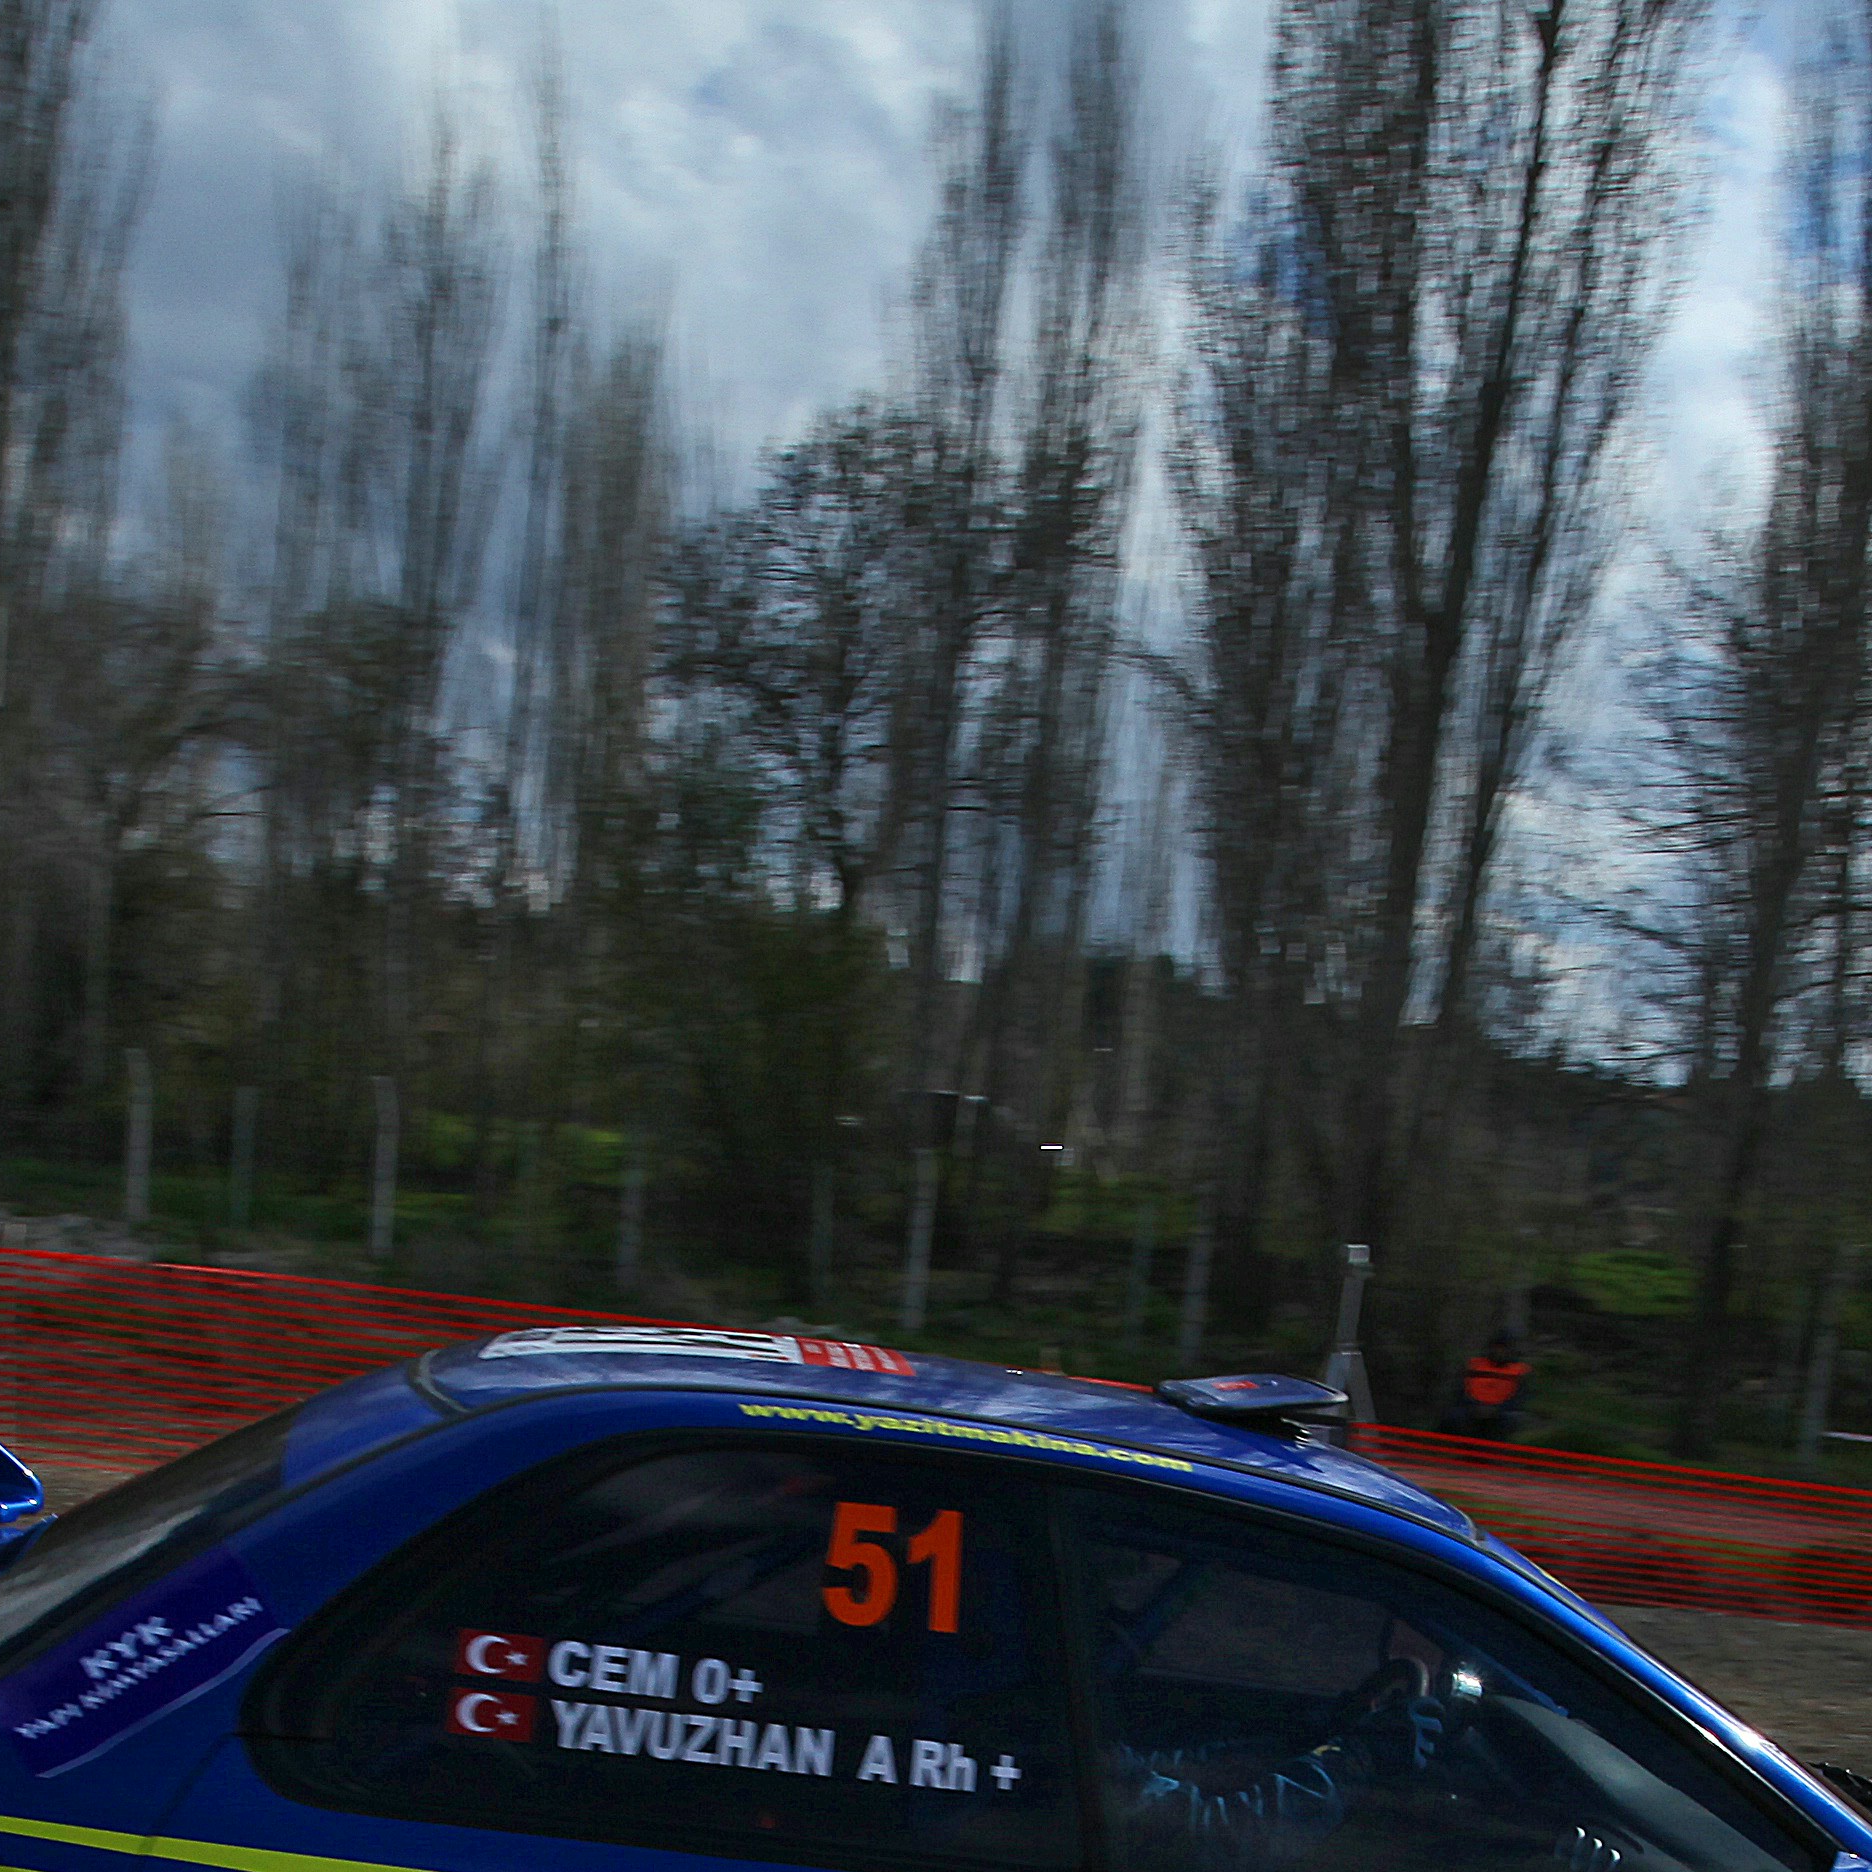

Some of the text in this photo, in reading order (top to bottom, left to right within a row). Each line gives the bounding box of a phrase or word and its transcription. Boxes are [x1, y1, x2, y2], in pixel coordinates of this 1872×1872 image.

[739, 1403, 1194, 1473] www.yazitmakina.com
[822, 1501, 965, 1634] 51
[547, 1640, 680, 1699] CEM
[551, 1699, 836, 1777] YAVUZHAN
[856, 1735, 898, 1784] A
[908, 1739, 978, 1792] Rh
